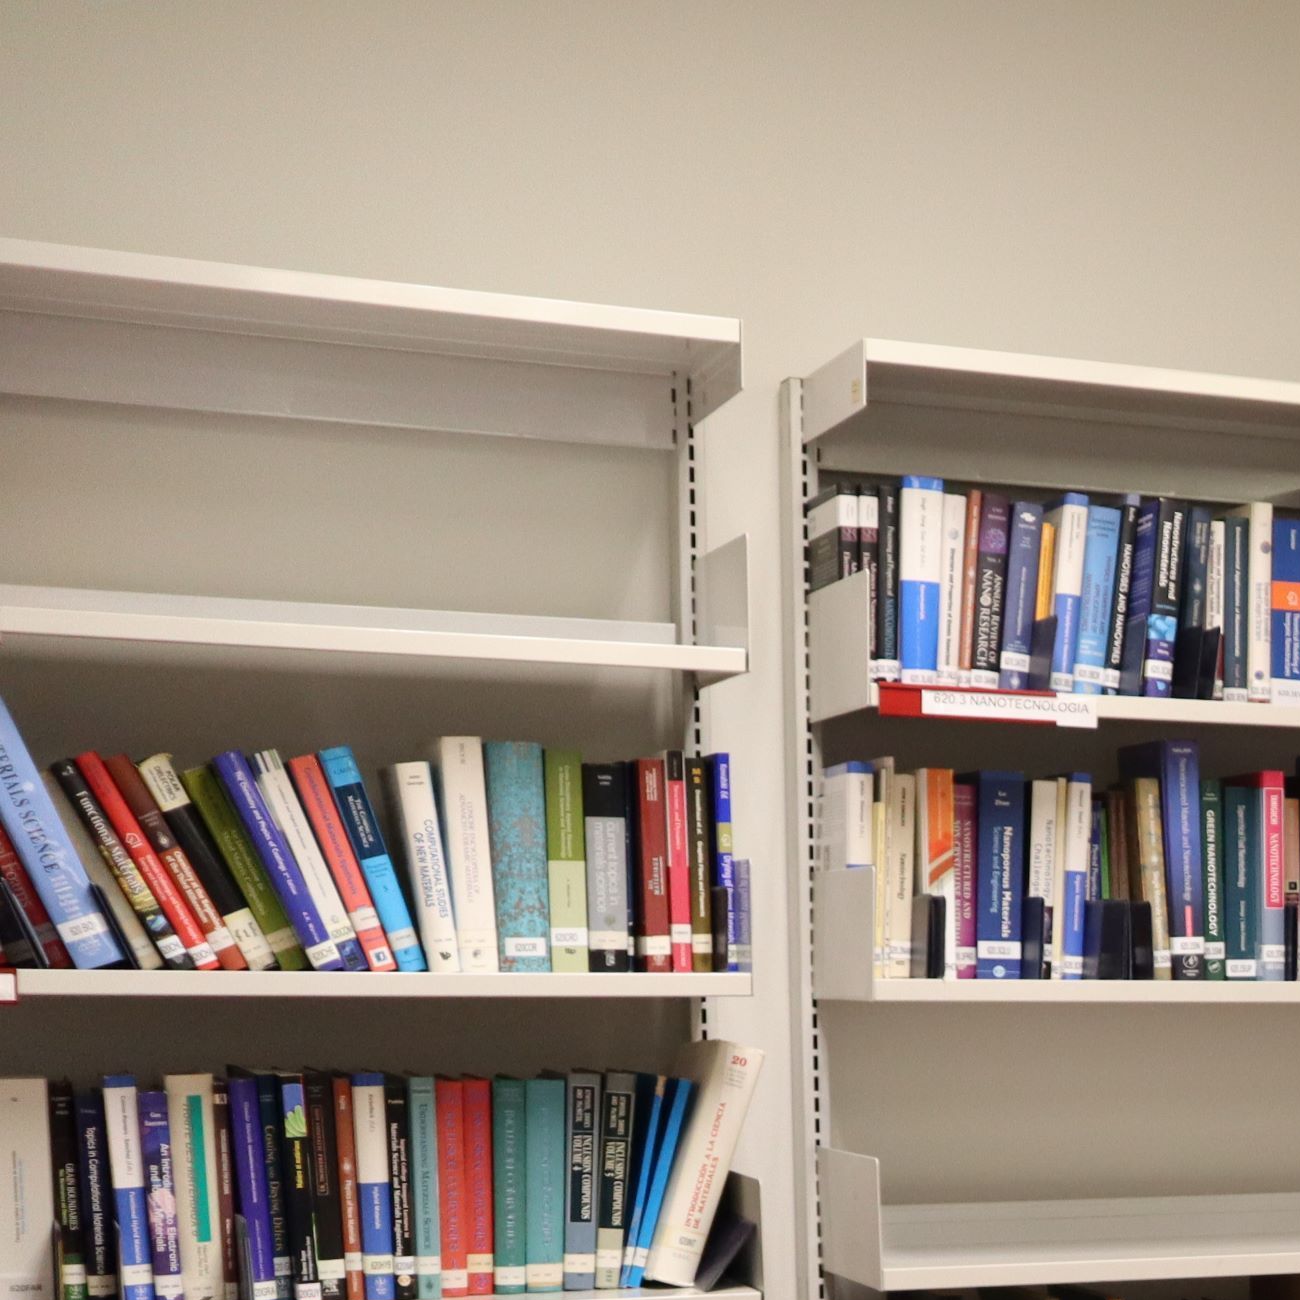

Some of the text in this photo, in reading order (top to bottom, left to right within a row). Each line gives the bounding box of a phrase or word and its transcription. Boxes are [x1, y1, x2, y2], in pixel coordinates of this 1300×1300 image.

[1159, 521, 1173, 588] Nanomaterials
[969, 694, 1090, 714] NANOTECNOLOGIA
[75, 790, 146, 896] Functional Materials
[423, 819, 449, 918] COMPUTATIONAL STUDIES
[1001, 825, 1014, 939] Nanoporous Materials
[1206, 809, 1218, 937] GREEN NANOTECHNOLOGY
[710, 1102, 727, 1139] CIENCIA
[700, 1156, 720, 1215] MATERIALES
